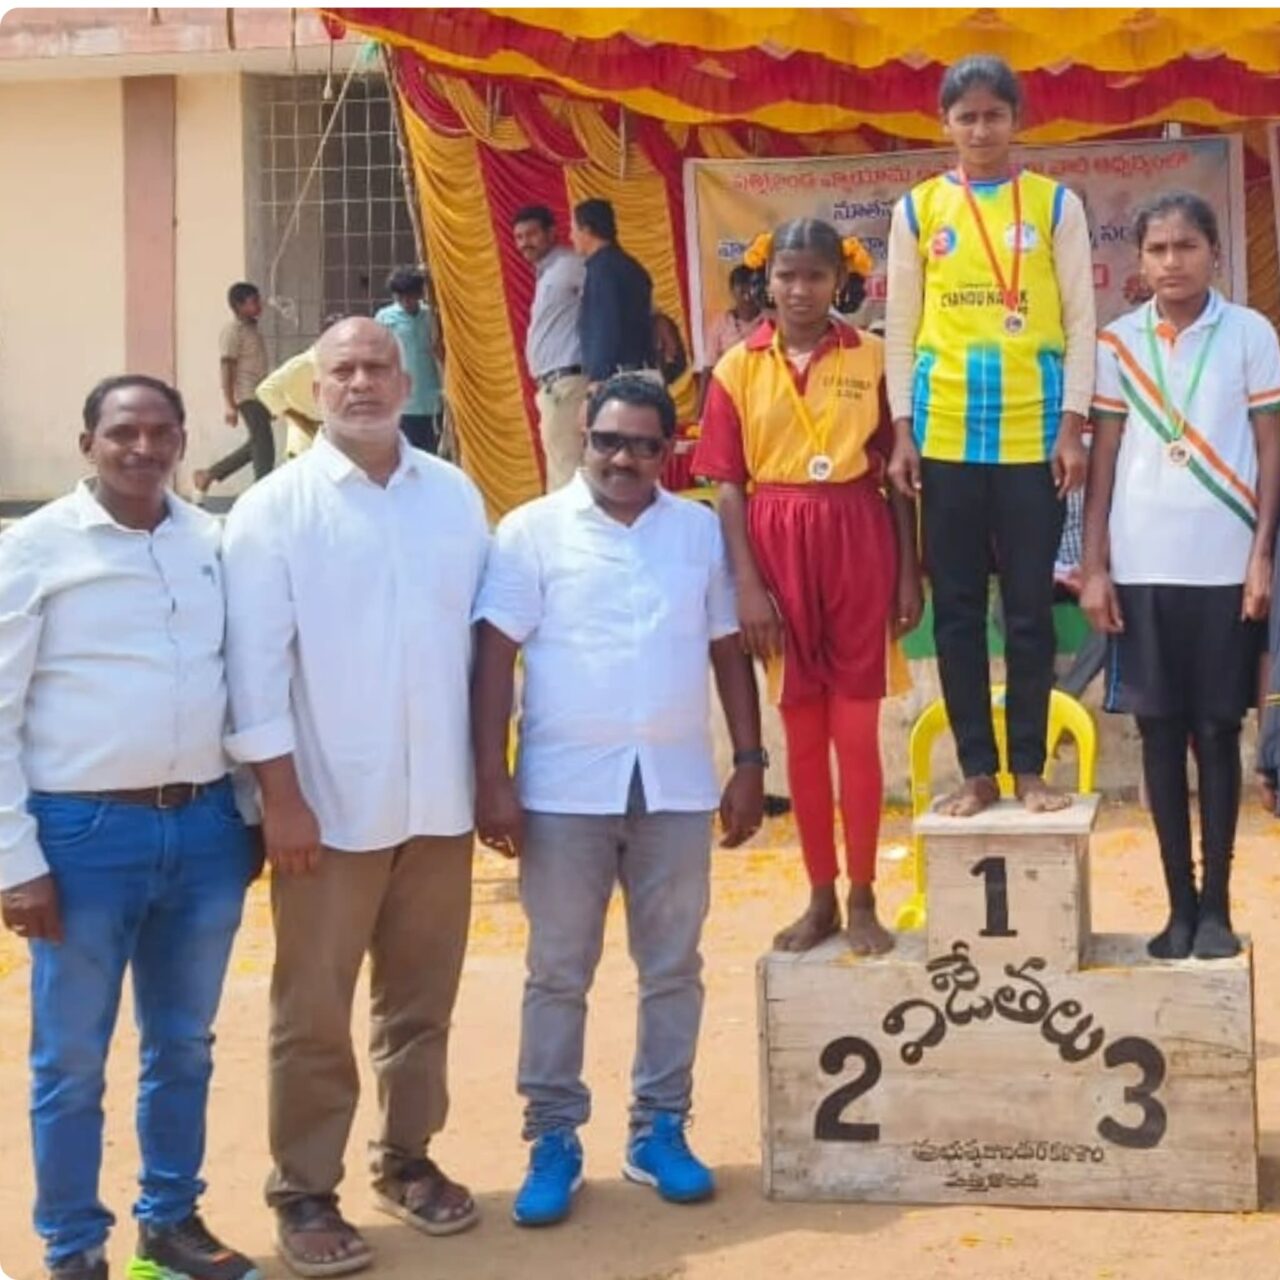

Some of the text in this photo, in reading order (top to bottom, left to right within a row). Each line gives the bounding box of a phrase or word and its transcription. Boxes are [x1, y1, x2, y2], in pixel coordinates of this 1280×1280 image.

[970, 856, 1018, 938] 1
[813, 1036, 882, 1143] 2
[1097, 1036, 1168, 1150] 3
